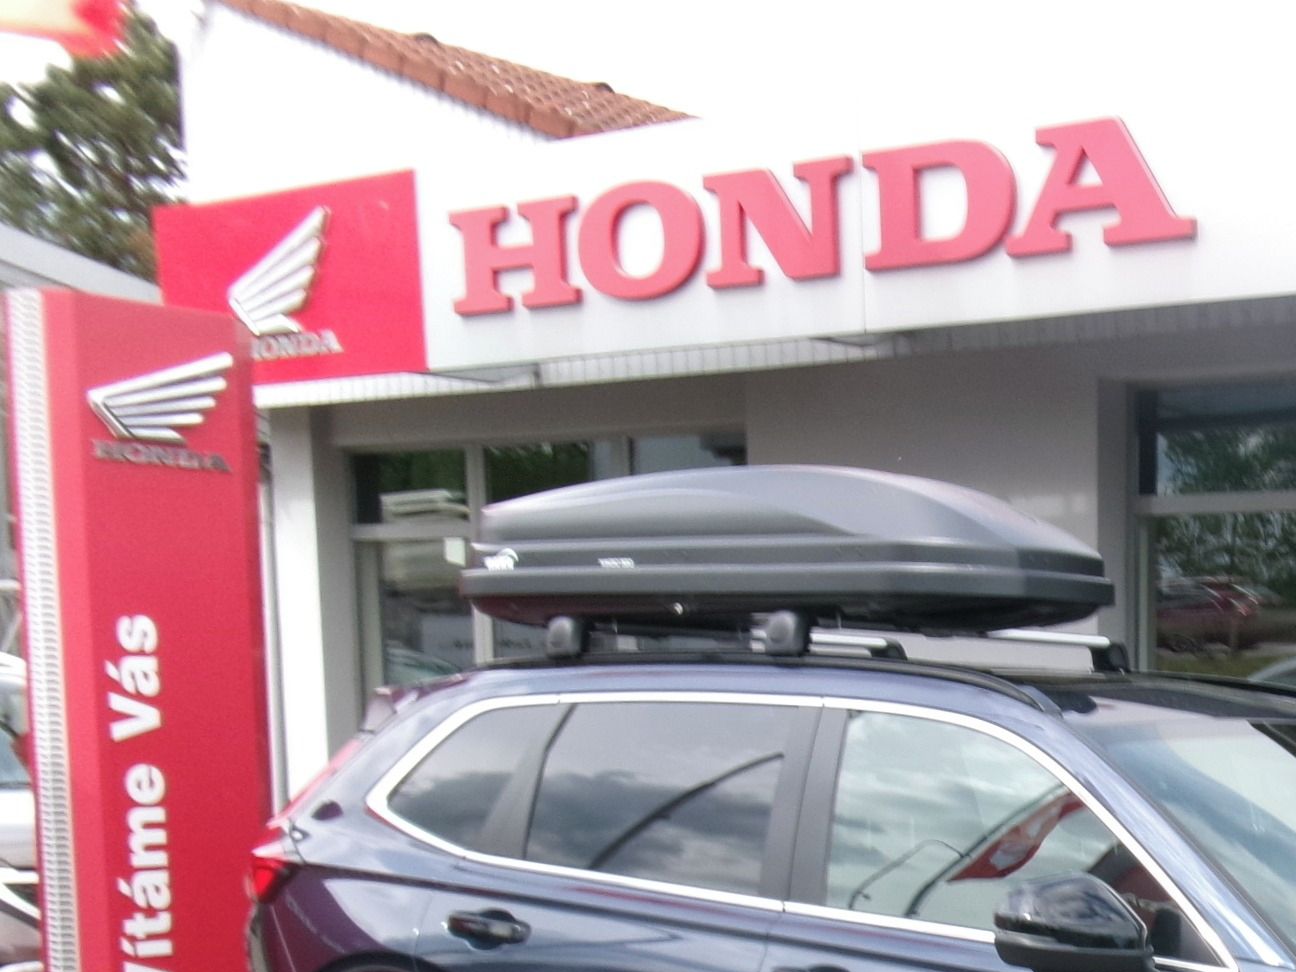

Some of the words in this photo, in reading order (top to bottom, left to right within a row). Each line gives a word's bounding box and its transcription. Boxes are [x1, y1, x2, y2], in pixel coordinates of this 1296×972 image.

[449, 116, 1198, 316] HONDA
[92, 439, 231, 473] HONDA
[104, 613, 162, 743] Vás
